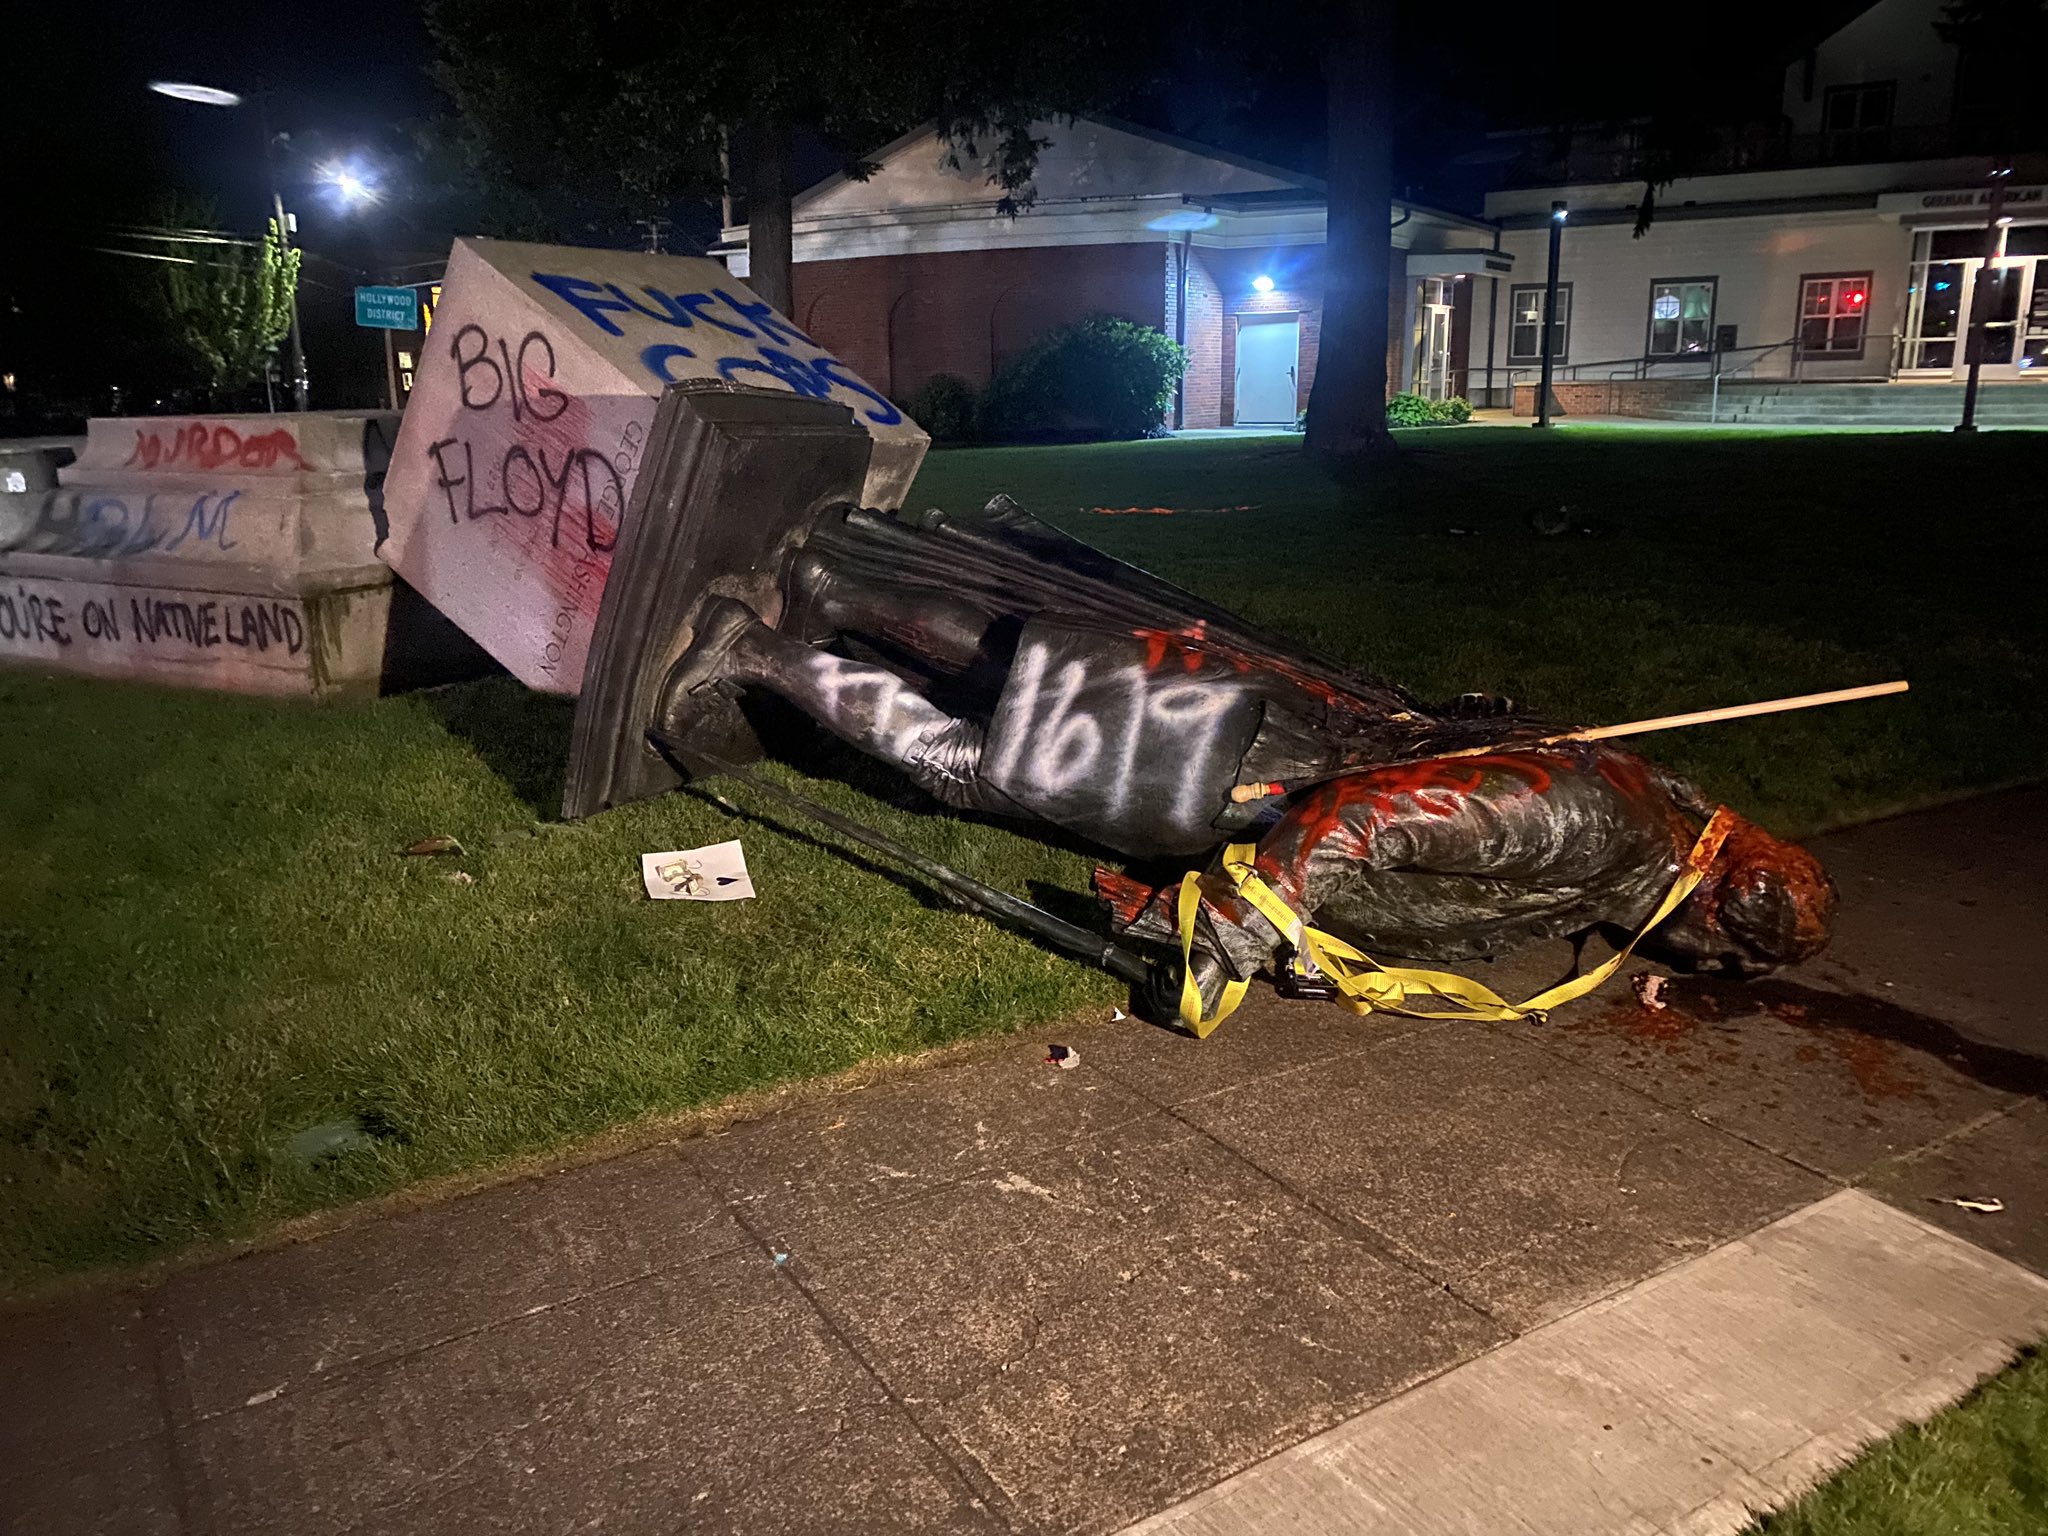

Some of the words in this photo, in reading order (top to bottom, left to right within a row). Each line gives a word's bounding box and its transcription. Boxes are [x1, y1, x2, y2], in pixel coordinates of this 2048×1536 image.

[360, 292, 412, 306] HOLLYWOOD
[367, 308, 405, 321] DISTRICT
[530, 272, 823, 349] FUCK
[451, 323, 568, 421] BIG
[428, 439, 624, 553] FLOYD
[82, 599, 120, 641] ON
[996, 641, 1247, 830] 1619
